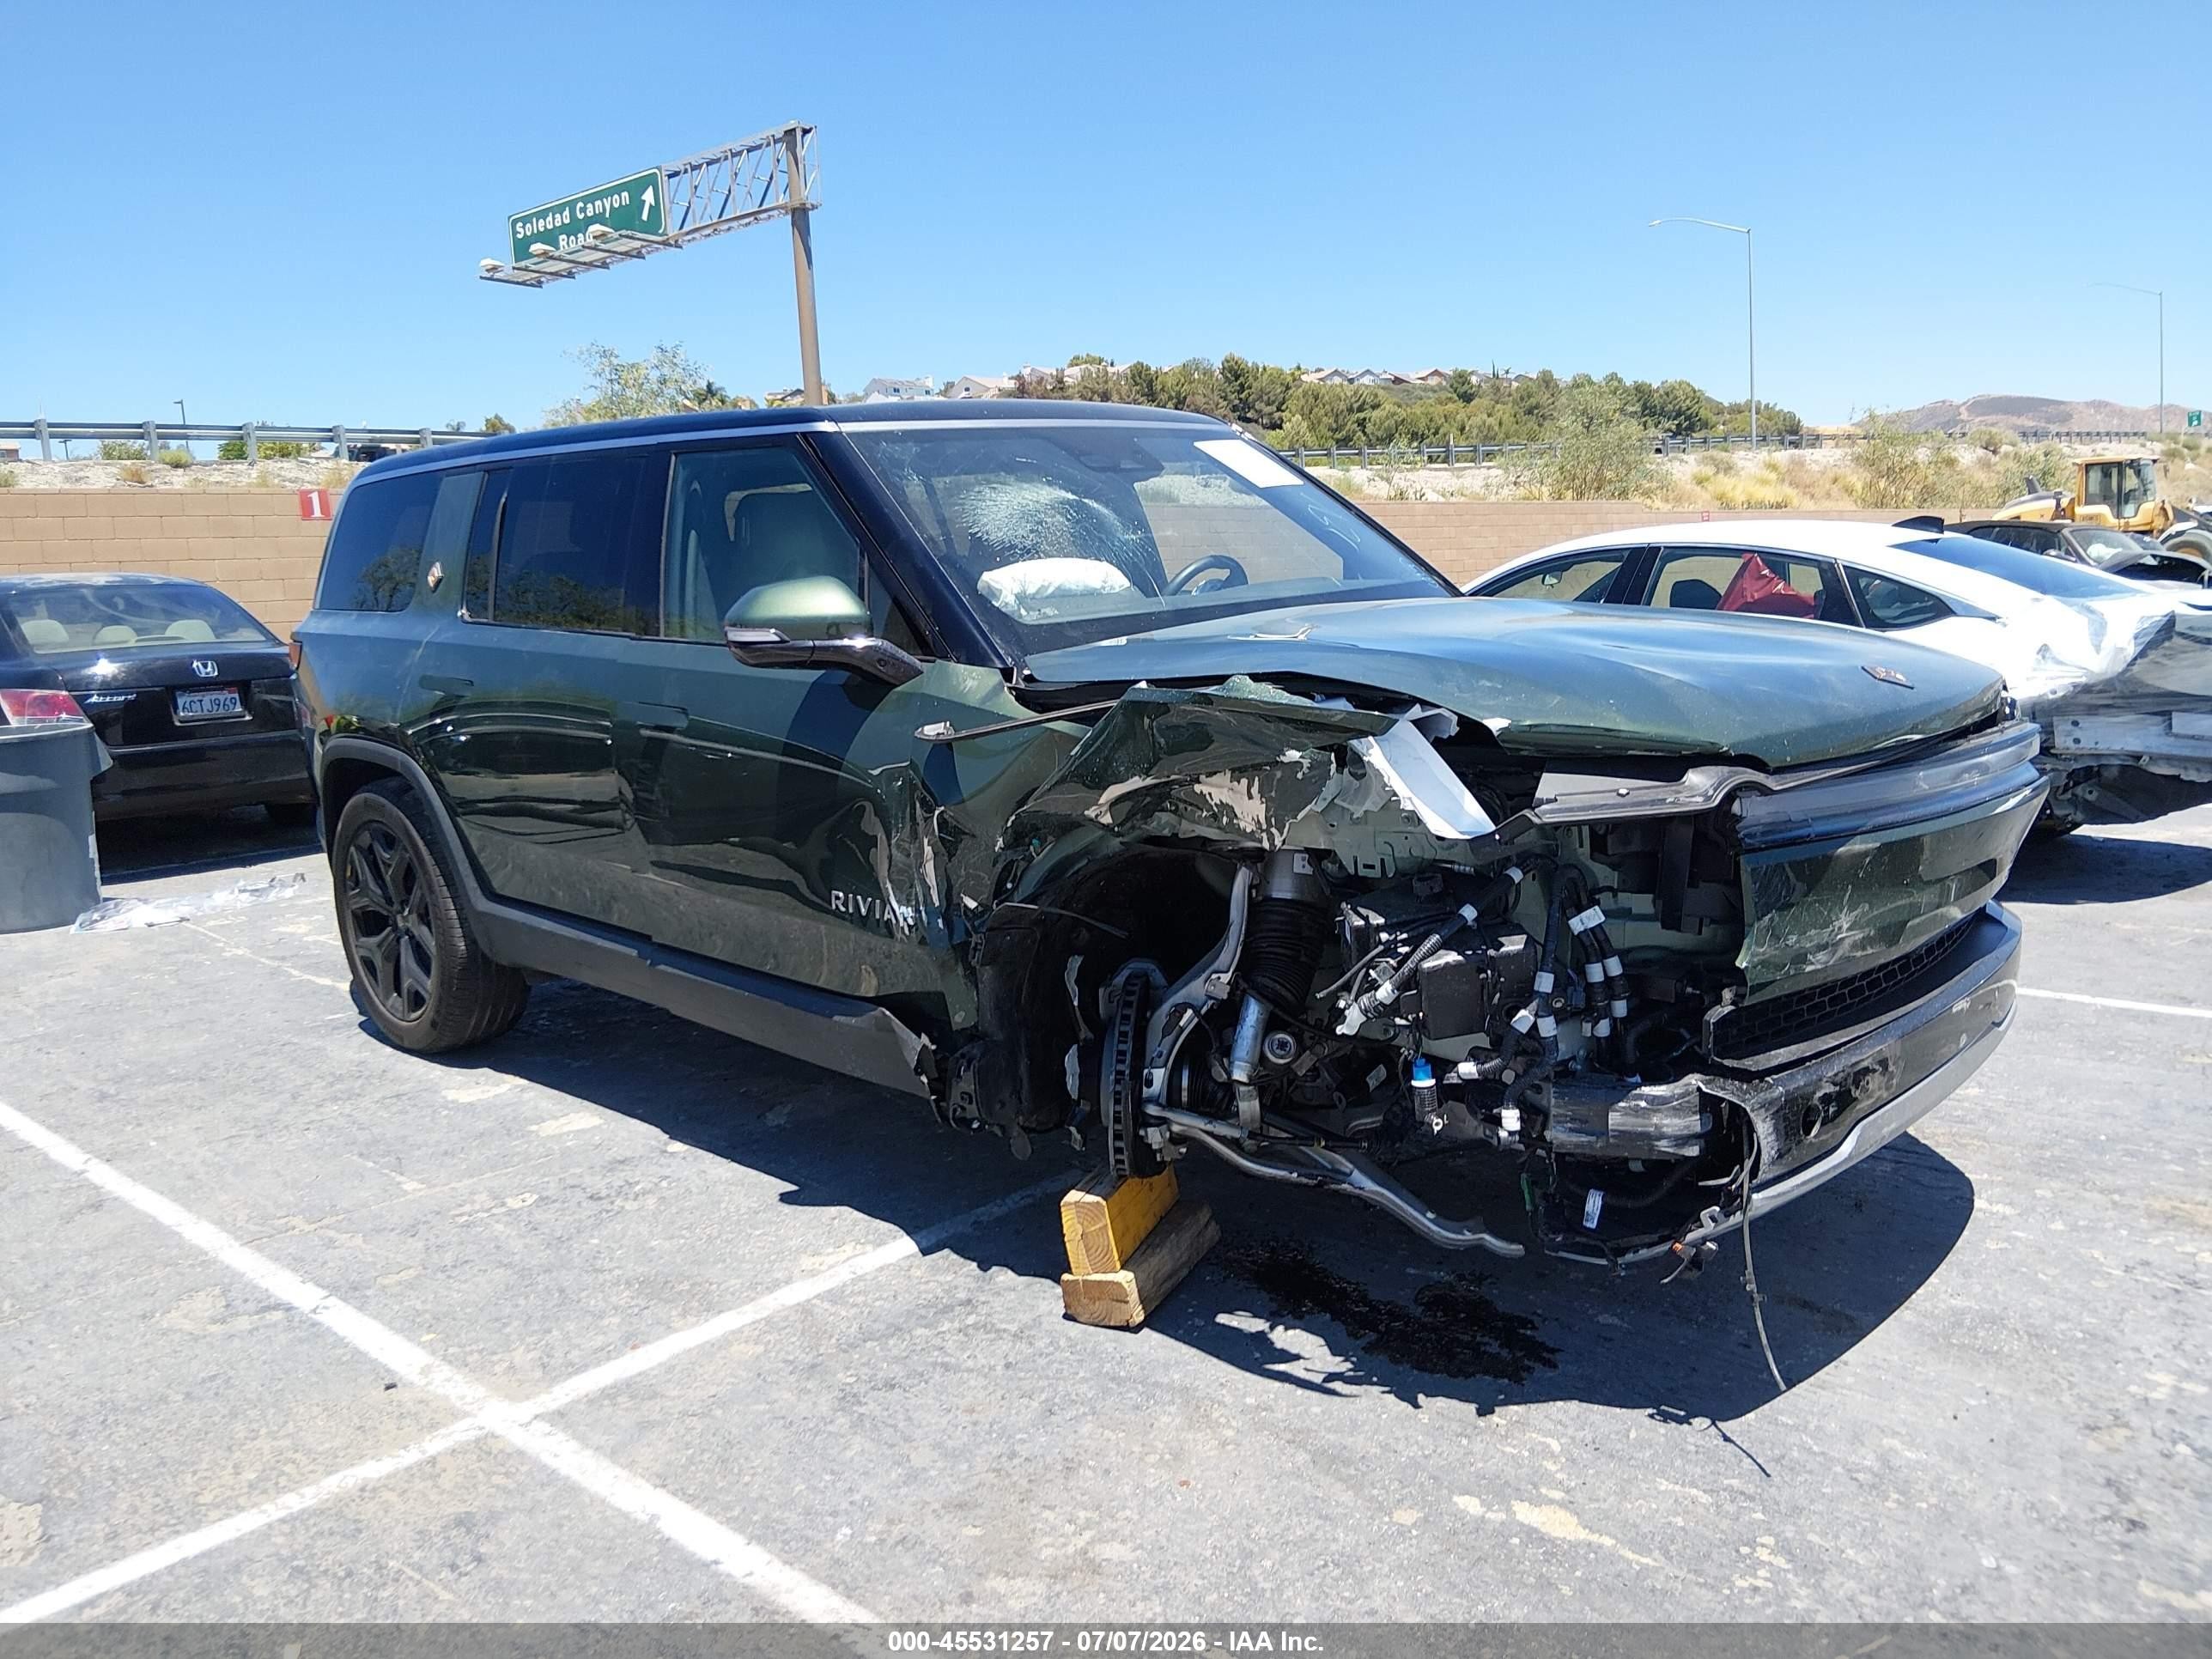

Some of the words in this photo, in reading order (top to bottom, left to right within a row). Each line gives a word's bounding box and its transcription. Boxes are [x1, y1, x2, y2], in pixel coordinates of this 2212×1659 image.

[515, 205, 570, 239] Soledad
[576, 190, 630, 219] Canyon
[307, 491, 325, 518] 1
[181, 696, 238, 714] 6CTJ969
